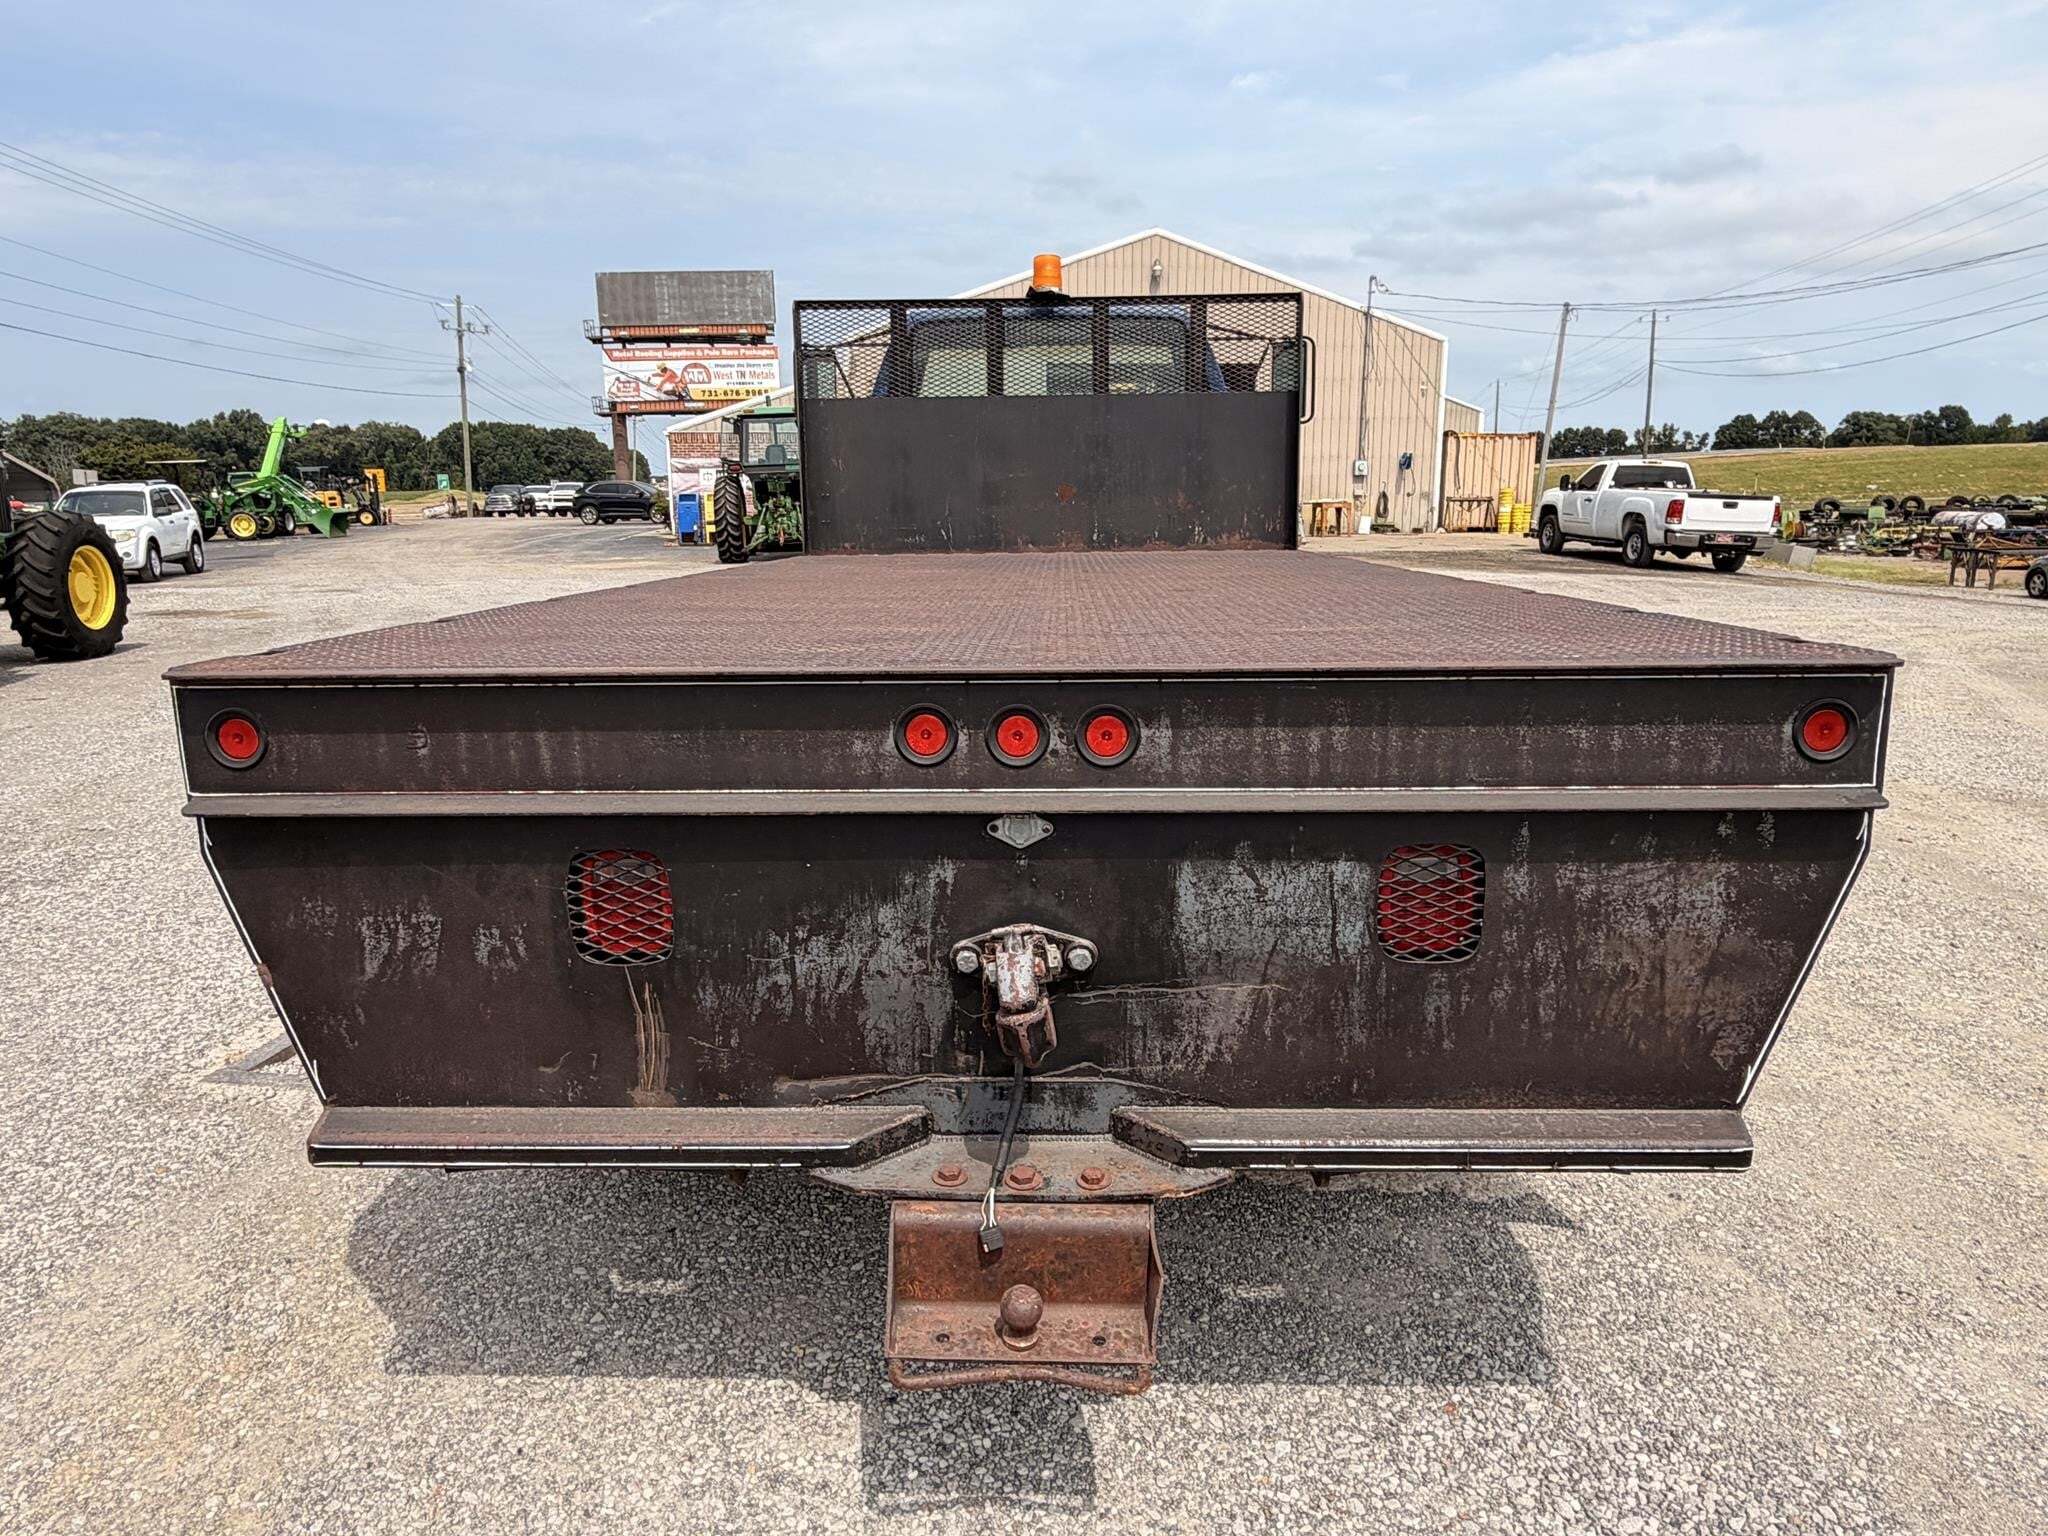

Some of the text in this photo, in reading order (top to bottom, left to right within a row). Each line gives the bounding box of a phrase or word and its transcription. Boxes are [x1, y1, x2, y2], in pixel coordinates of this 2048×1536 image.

[714, 370, 775, 380] West TN Metals
